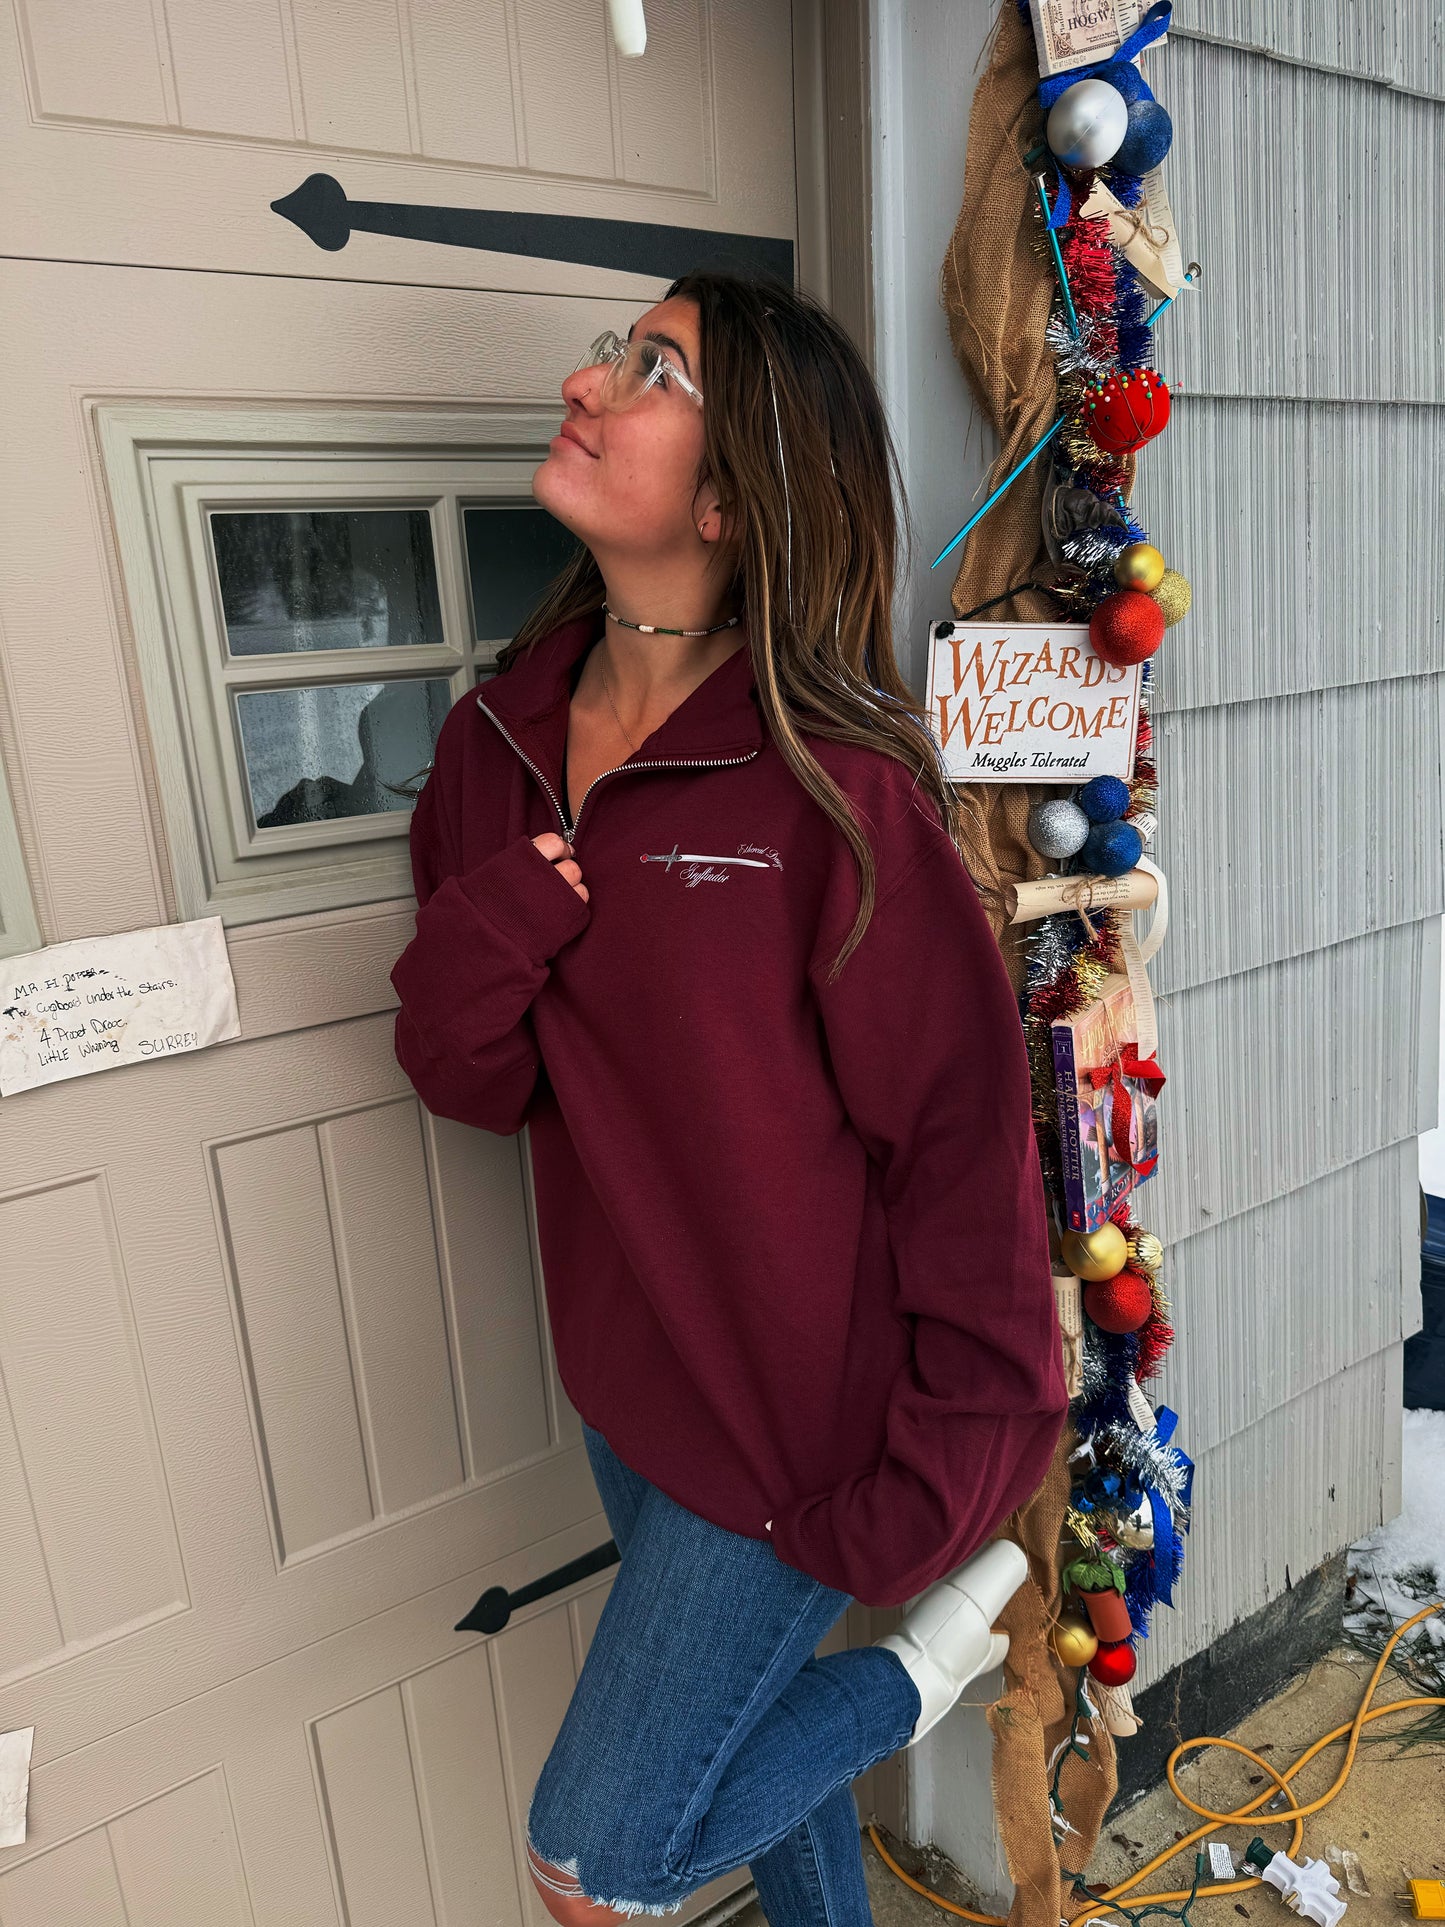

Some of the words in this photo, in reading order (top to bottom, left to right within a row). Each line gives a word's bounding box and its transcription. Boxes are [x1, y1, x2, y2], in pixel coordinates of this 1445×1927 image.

[948, 637, 1127, 697] WIZARDS
[935, 693, 1130, 751] WELCOME
[971, 752, 1027, 772] Muggles
[1029, 751, 1090, 768] Tolerated
[2, 1005, 30, 1020] The
[116, 985, 134, 998] the
[138, 1031, 199, 1056] SURREY
[1064, 1070, 1077, 1123] HARRY
[1069, 1129, 1080, 1181] POTTER
